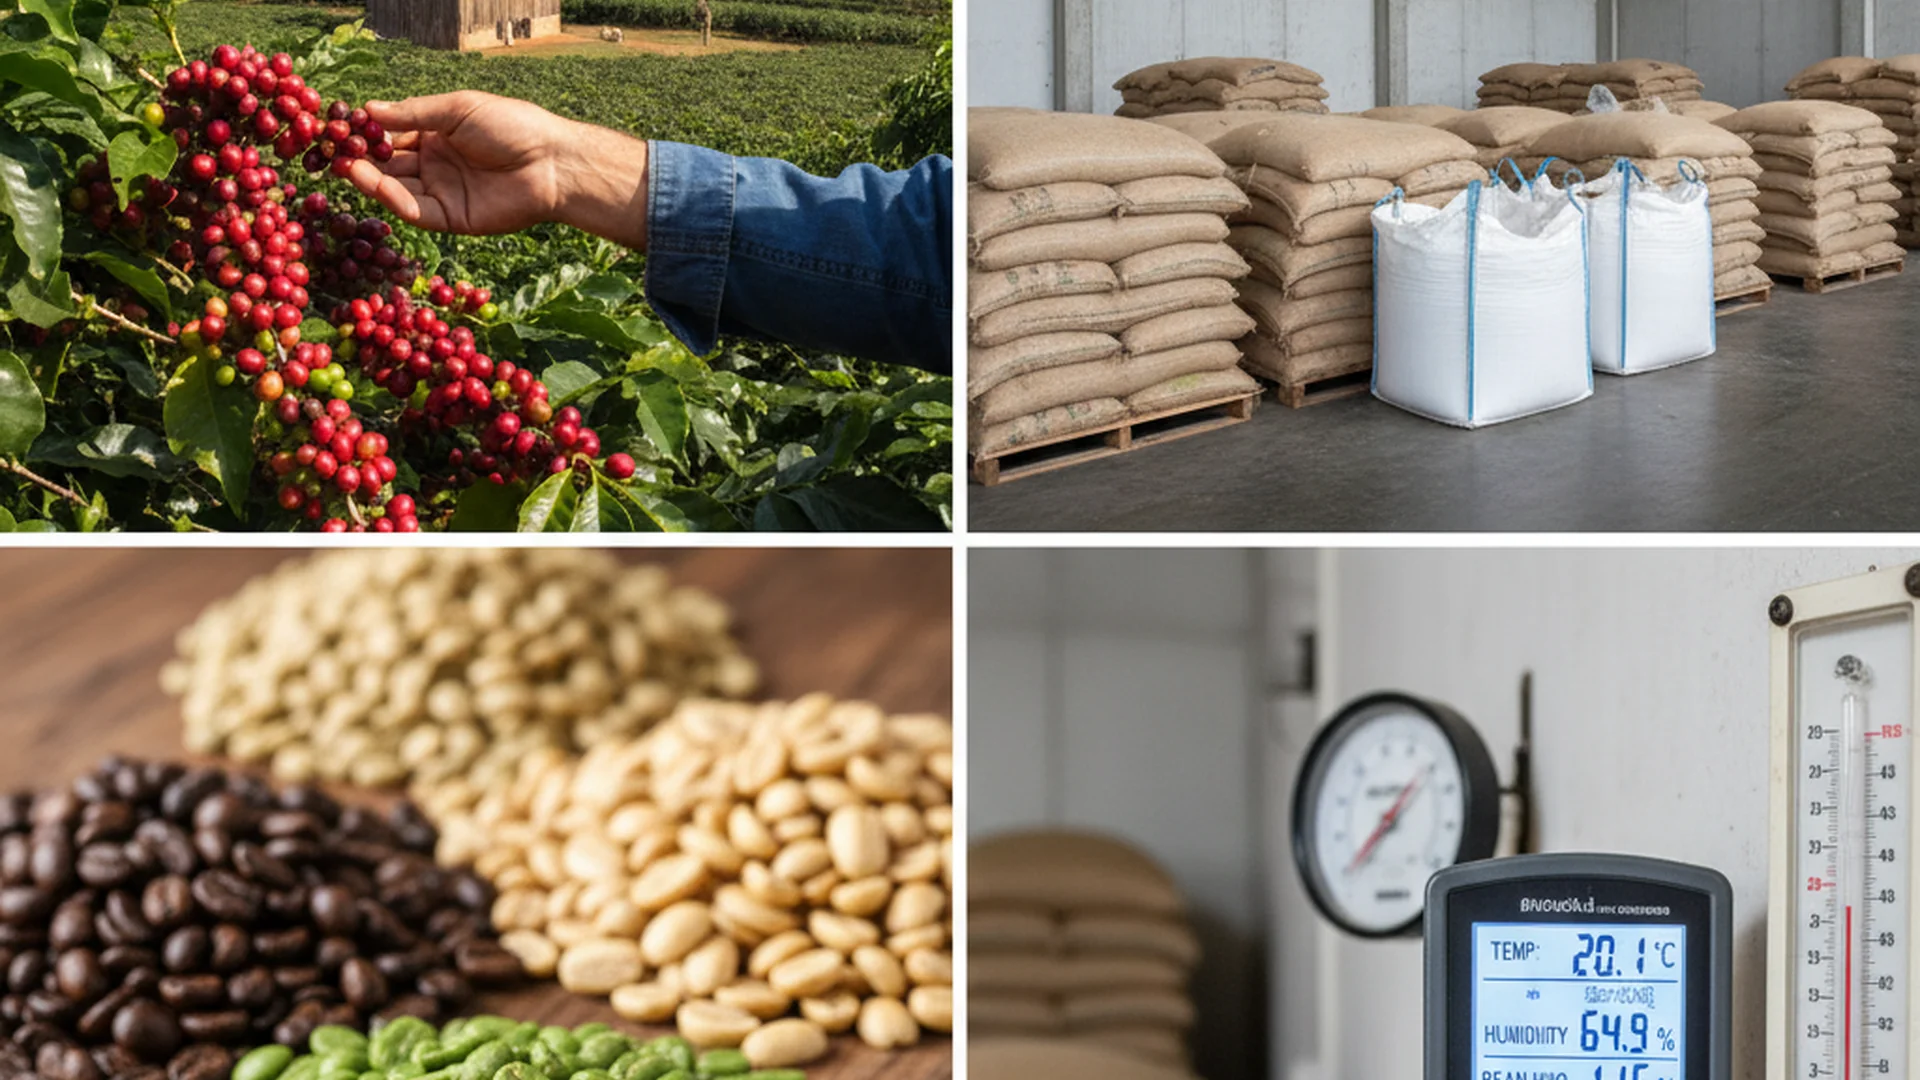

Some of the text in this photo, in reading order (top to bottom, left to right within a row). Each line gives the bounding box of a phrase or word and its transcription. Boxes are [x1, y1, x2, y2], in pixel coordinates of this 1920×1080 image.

[1491, 941, 1540, 960] TEMP:
[1573, 933, 1645, 976] 20.1
[1580, 1010, 1648, 1053] 64.9
